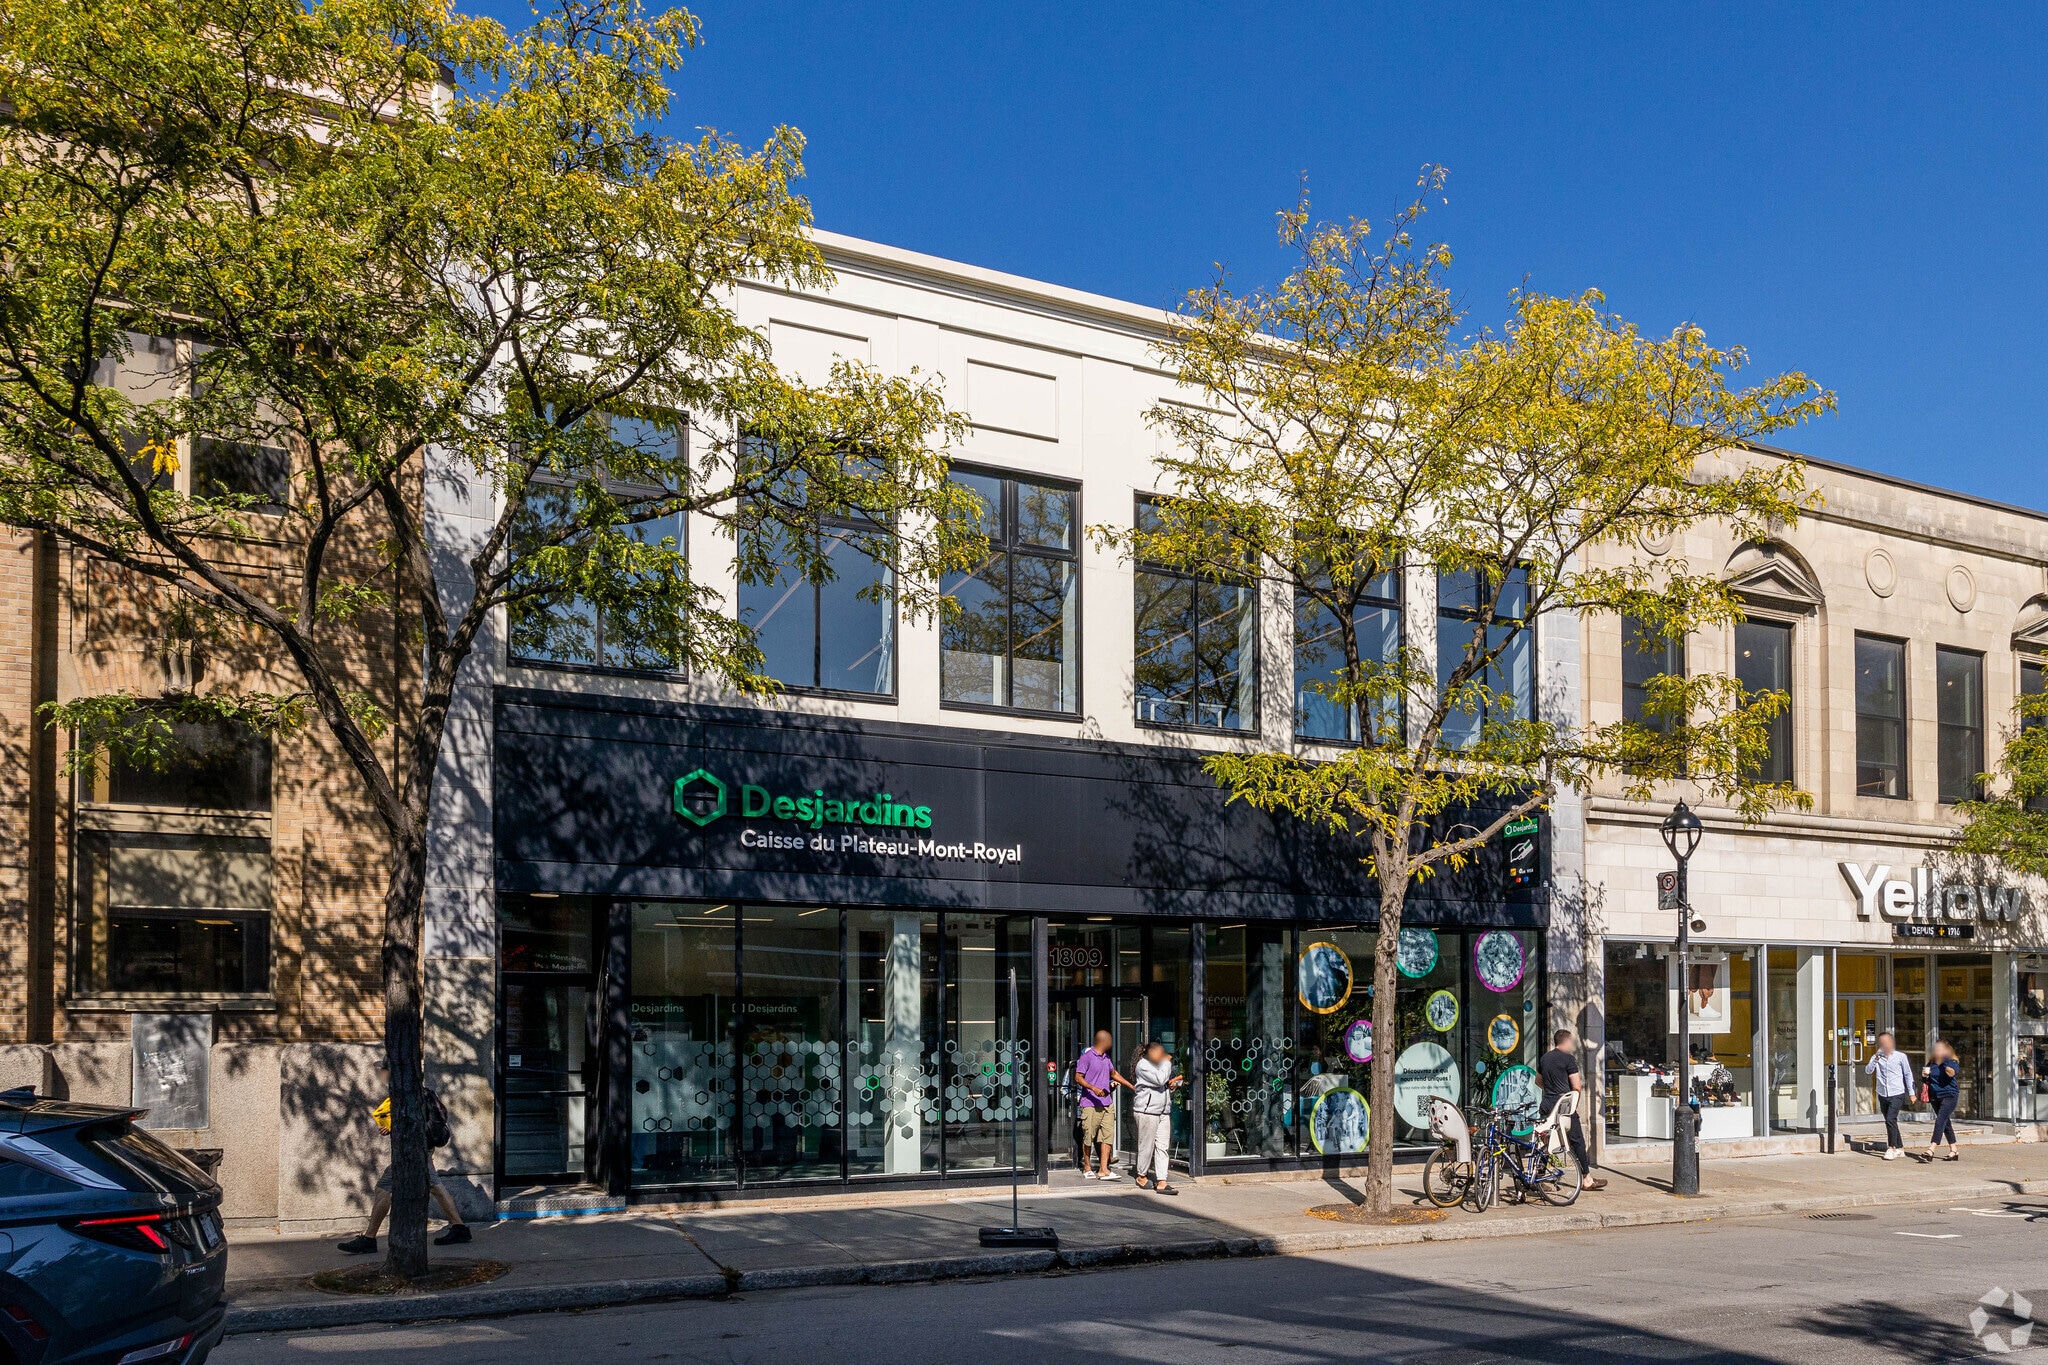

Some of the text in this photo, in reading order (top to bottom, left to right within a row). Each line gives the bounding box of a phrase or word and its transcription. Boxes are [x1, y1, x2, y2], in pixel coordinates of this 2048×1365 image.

[741, 783, 933, 830] Desjardins
[740, 829, 1022, 865] Caisse du Plateau-Mont-Royal
[1838, 862, 2023, 922] Yellow
[1911, 926, 1961, 936] DEPUIS 1916
[1050, 948, 1103, 967] 1809
[632, 1003, 684, 1014] Desjardins
[748, 1003, 798, 1014] Desjardins
